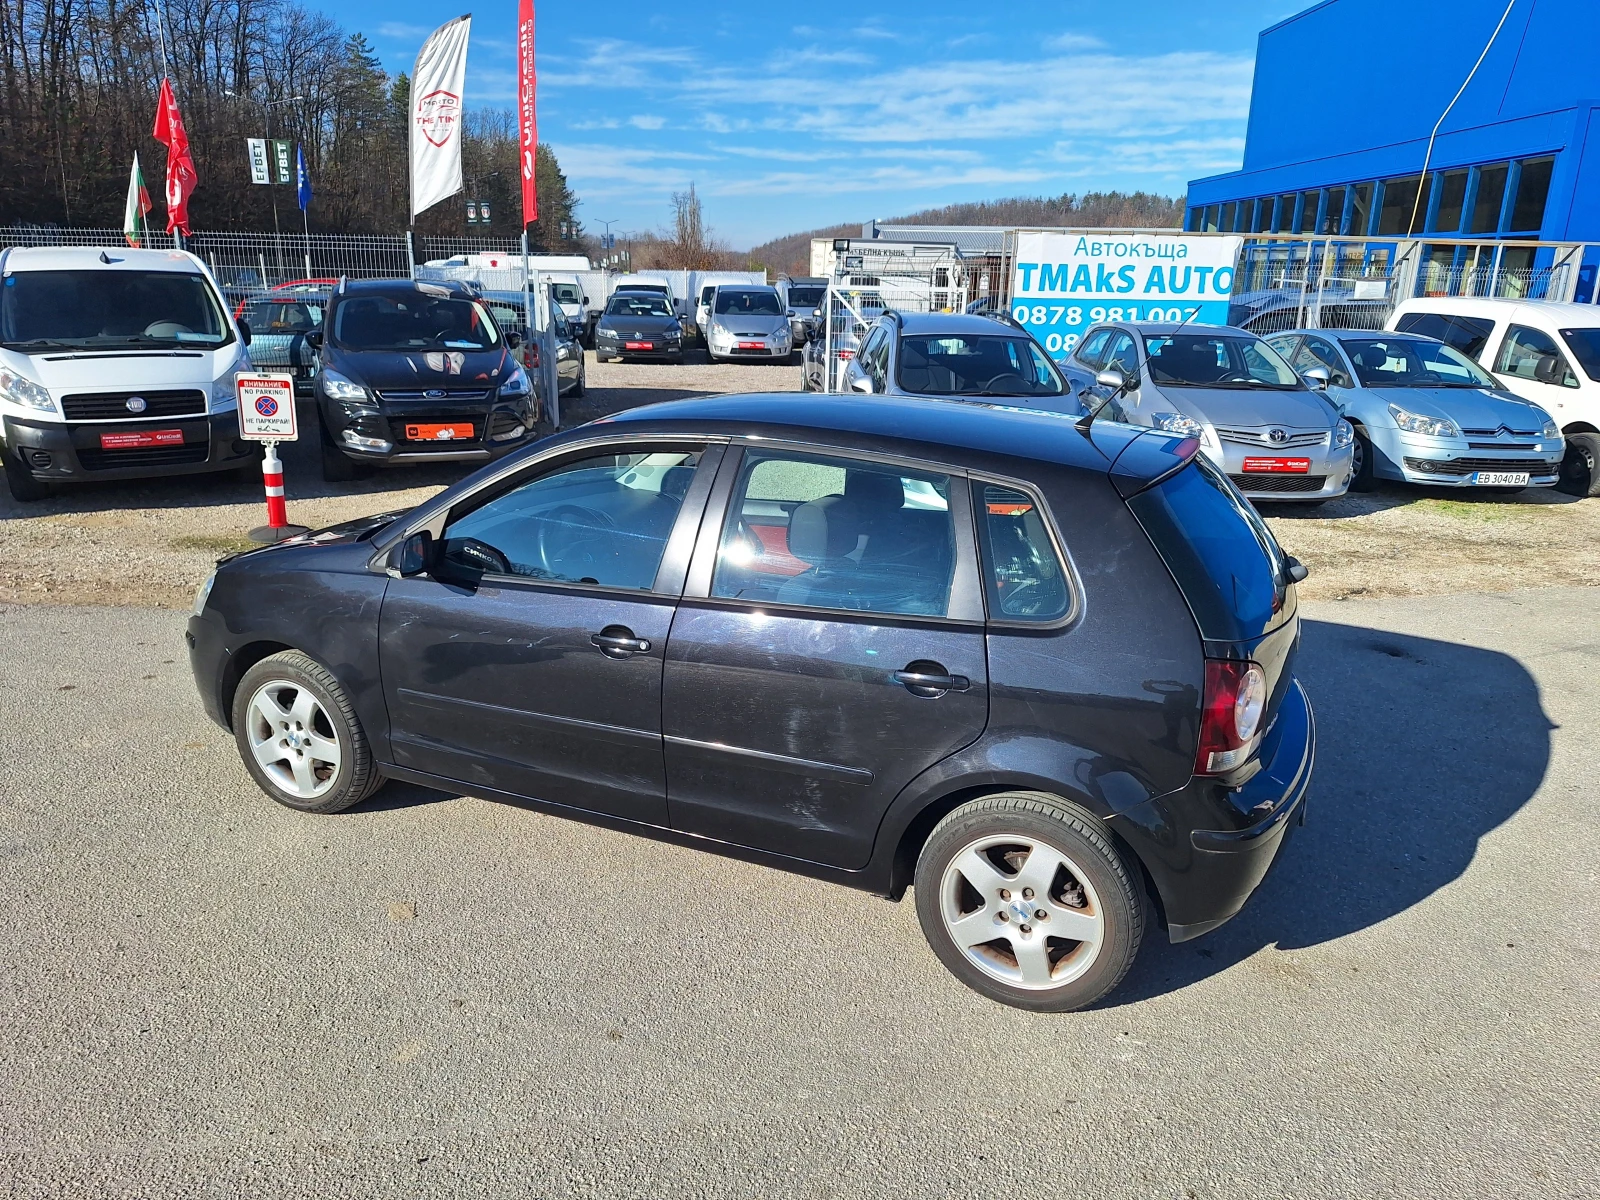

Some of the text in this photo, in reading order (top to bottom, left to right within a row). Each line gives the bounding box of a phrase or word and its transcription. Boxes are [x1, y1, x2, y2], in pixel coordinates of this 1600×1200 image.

[416, 116, 434, 124] THE
[253, 142, 265, 181] EFBET
[277, 142, 290, 182] EFBET
[1074, 237, 1188, 262] Автокъща
[1018, 263, 1234, 295] TMAkS AUTO
[1012, 305, 1083, 326] 0878
[1090, 306, 1138, 324] 981
[243, 380, 285, 388] ВНИМАНИЕ!
[1477, 473, 1526, 484] EB 3040 BA
